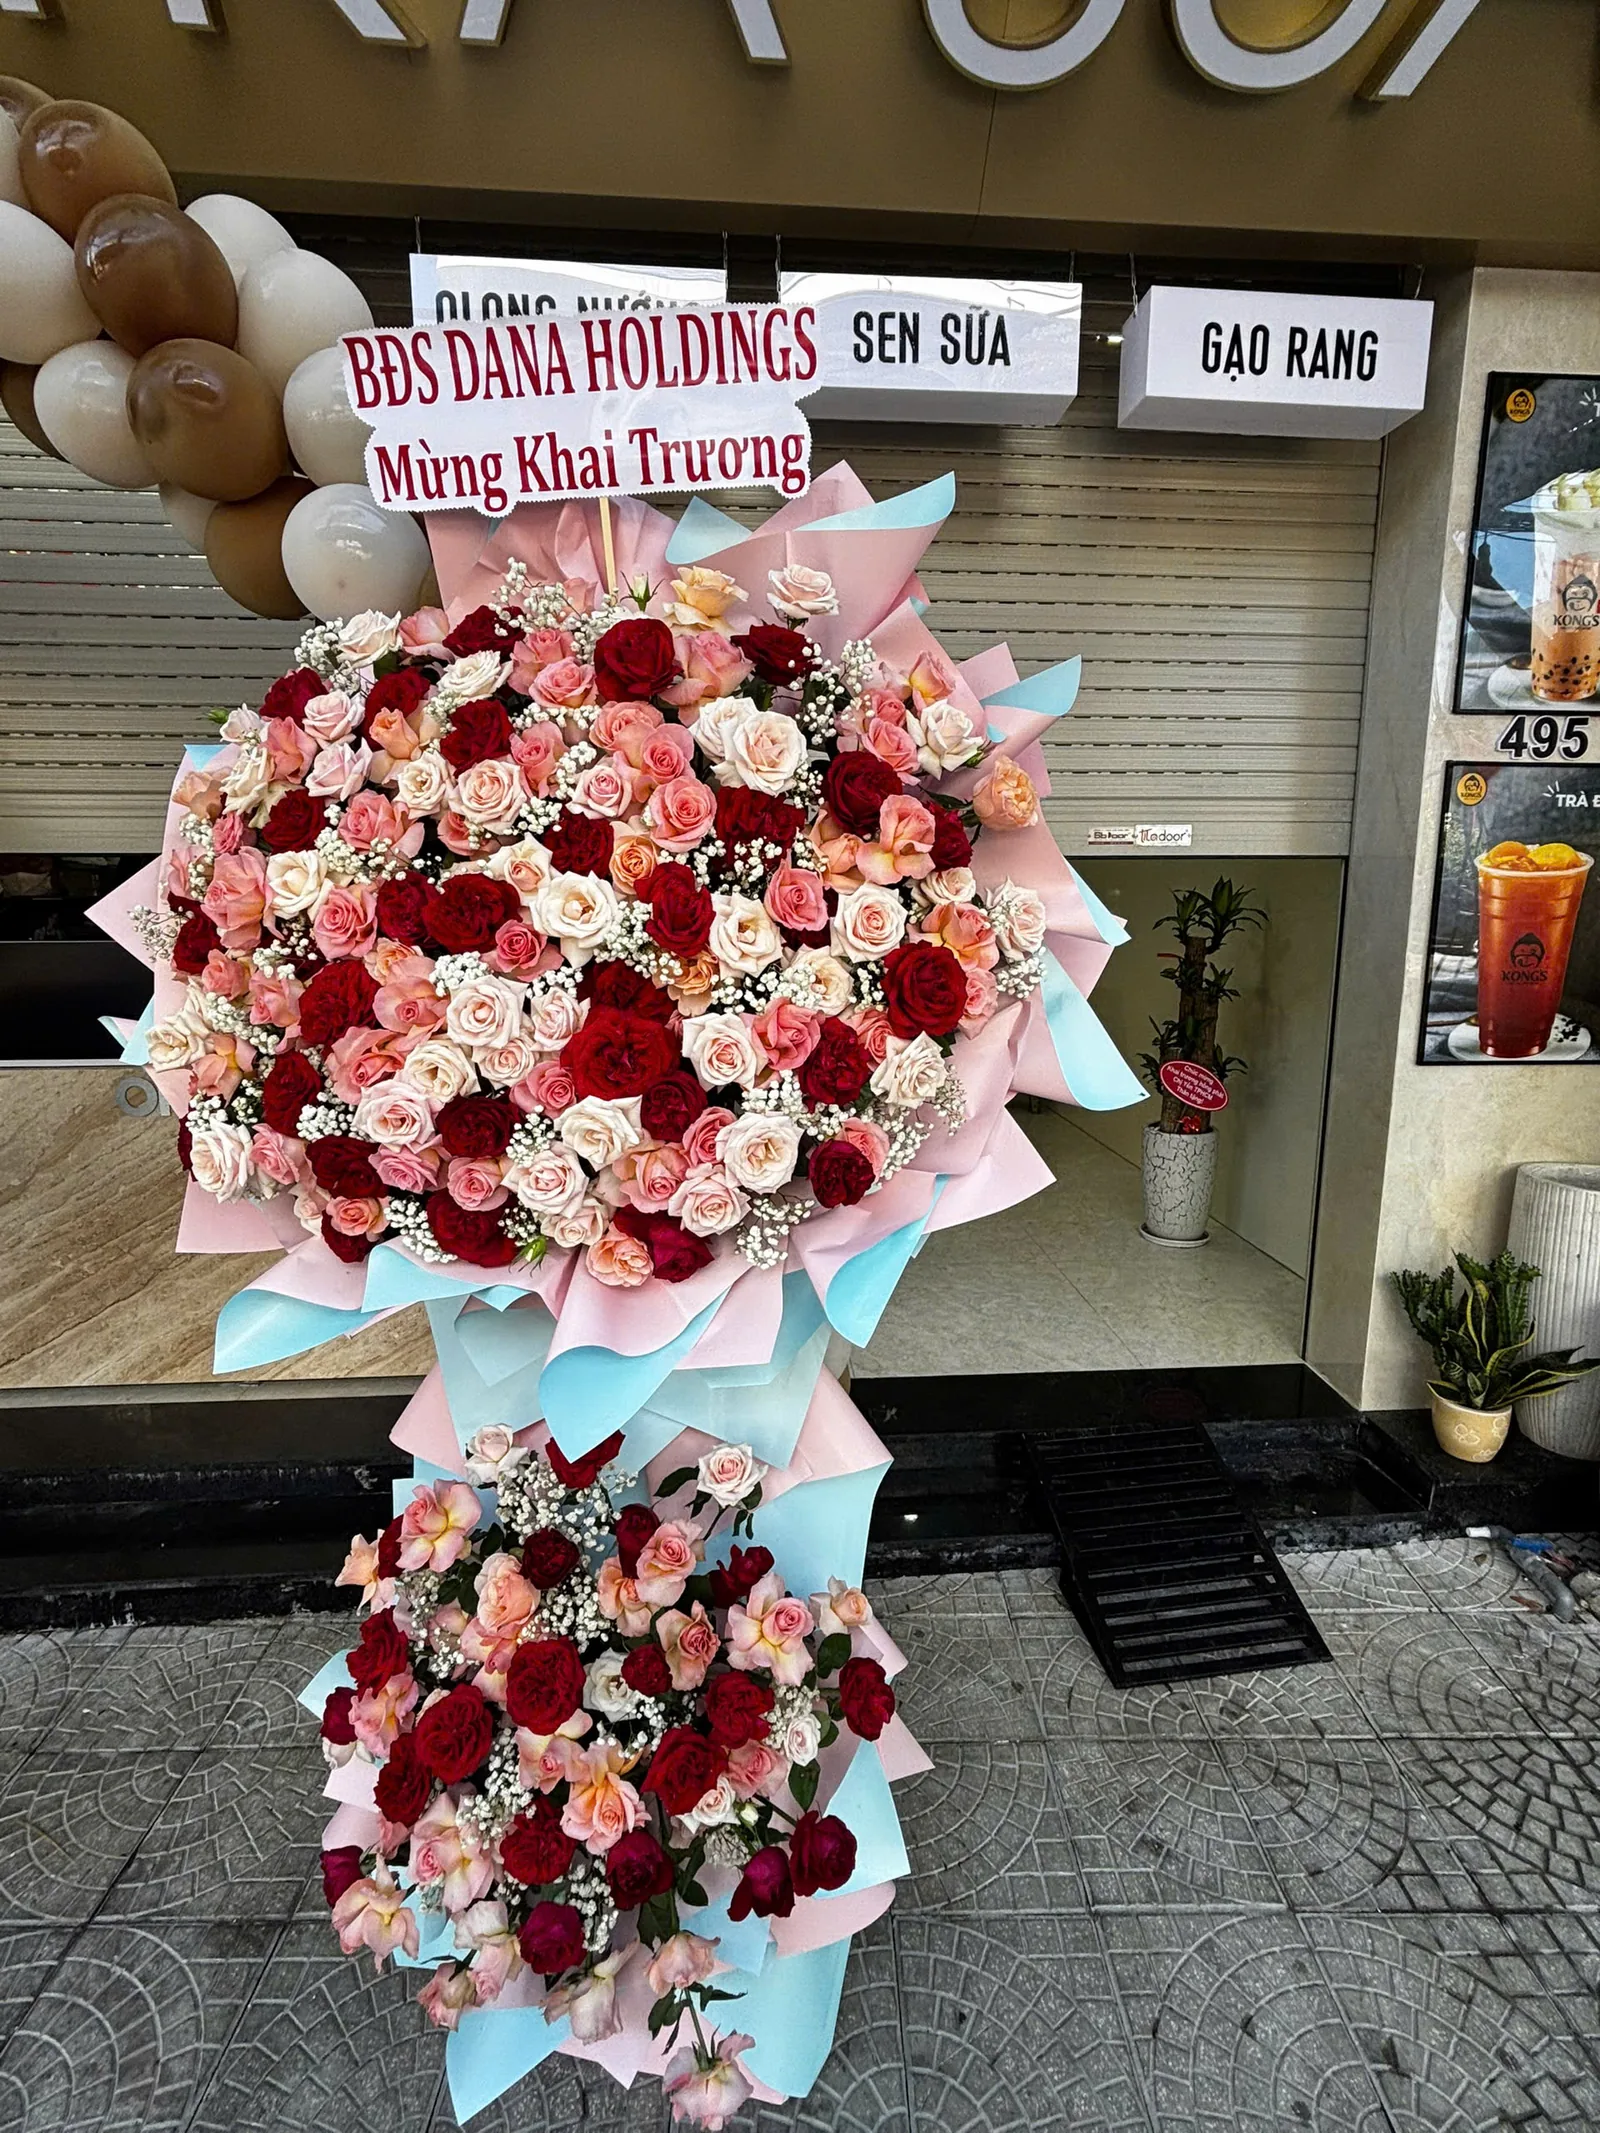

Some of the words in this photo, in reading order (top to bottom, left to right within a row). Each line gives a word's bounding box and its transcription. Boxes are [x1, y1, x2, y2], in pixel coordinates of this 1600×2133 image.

[342, 331, 439, 409] BĐS
[442, 322, 576, 402] DANA
[579, 306, 818, 393] HOLDINGS
[852, 310, 920, 364] SEN
[940, 304, 1012, 367] SỮA
[1201, 321, 1271, 383] GẠO
[1286, 325, 1379, 383] RANG
[373, 438, 507, 512] Mừng
[513, 429, 620, 493] Khai
[627, 426, 806, 496] Trương
[1497, 713, 1591, 760] 495
[1555, 790, 1589, 808] TRÀ
